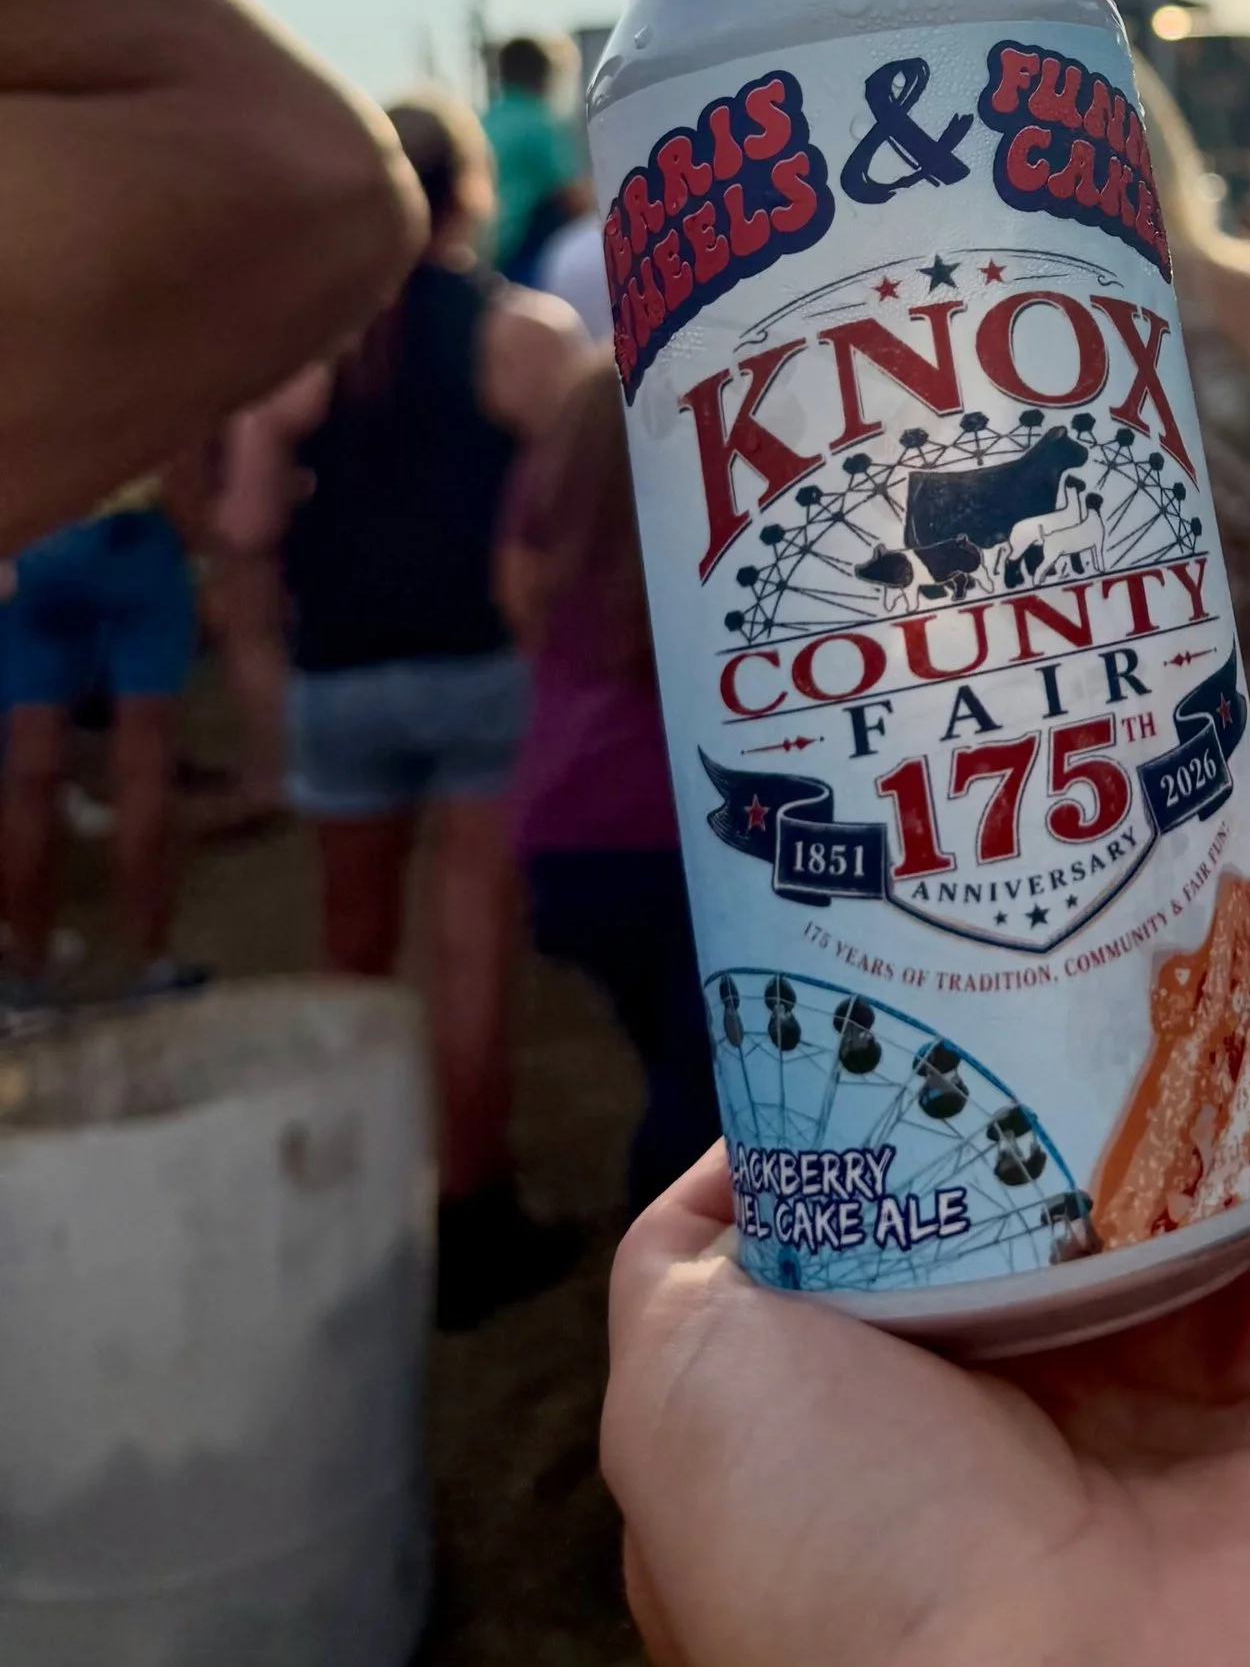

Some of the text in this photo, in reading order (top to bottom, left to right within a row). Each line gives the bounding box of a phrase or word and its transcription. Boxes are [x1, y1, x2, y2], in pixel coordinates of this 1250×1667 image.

[604, 79, 791, 289] ERRIS
[841, 57, 975, 204] &
[1007, 125, 1172, 264] CAKE
[679, 290, 1198, 585] KNOX
[720, 557, 1209, 718] COUNTY
[843, 647, 1151, 759] FAIR
[1159, 753, 1218, 807] 2026
[793, 840, 865, 877] 1851
[803, 919, 828, 949] 175
[835, 940, 894, 980] YEARS
[902, 966, 930, 987] OF
[1064, 909, 1168, 978] COMMUNITY
[1169, 897, 1184, 915] &
[1182, 862, 1212, 903] FAIR
[1207, 820, 1230, 865] FUN!
[911, 826, 1138, 903] ANNIVERSARY
[733, 1144, 894, 1201] ACKBERRY
[775, 1197, 866, 1253] CAKE
[876, 1188, 970, 1252] ALE
